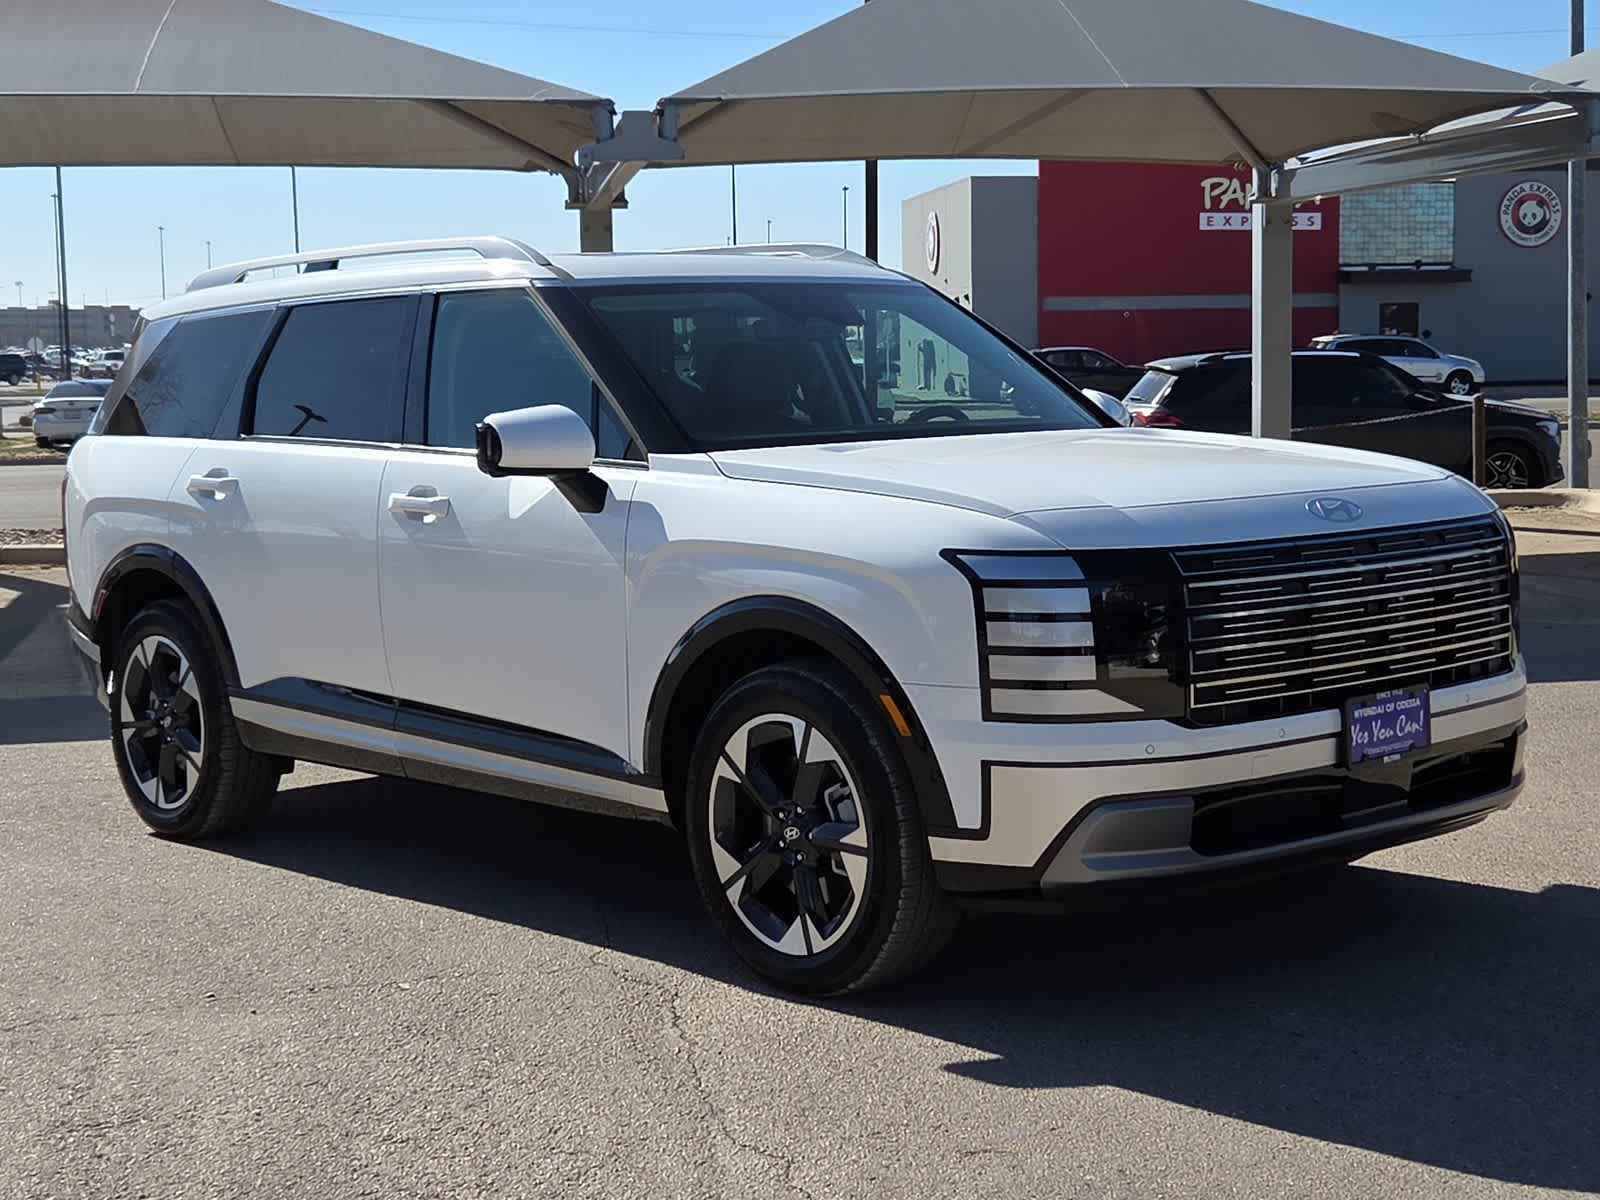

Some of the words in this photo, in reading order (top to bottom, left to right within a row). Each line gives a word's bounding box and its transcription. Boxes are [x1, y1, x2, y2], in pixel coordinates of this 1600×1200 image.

[1503, 186, 1526, 216] PANDA
[1529, 183, 1560, 214] EXPRESS
[1206, 215, 1316, 227] EXPSS
[1385, 703, 1394, 712] OF
[1351, 723, 1369, 747] Yes
[1372, 719, 1394, 742] You
[1396, 710, 1424, 737] Can!
